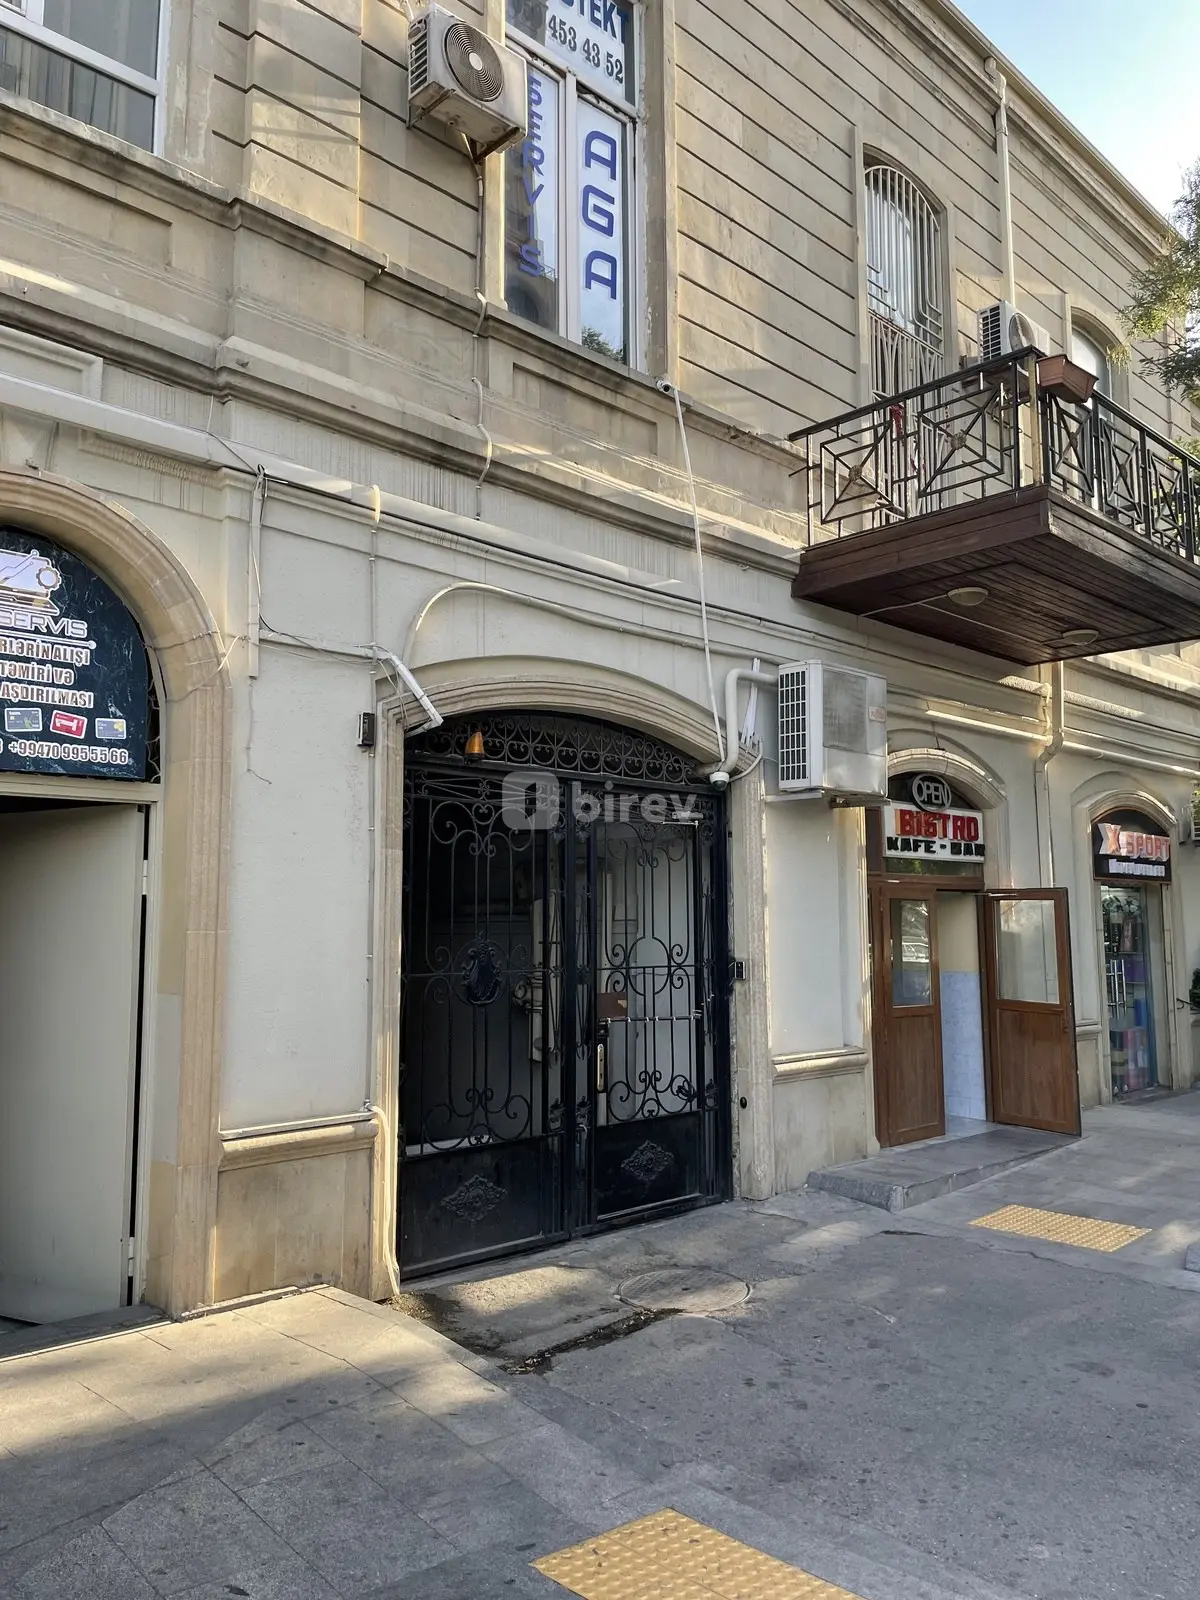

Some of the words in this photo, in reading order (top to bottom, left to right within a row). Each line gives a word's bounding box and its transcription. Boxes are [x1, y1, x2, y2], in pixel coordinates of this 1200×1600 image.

[549, 14, 577, 52] 453
[583, 38, 601, 68] 43
[606, 52, 624, 84] 52
[581, 130, 617, 300] AGA
[52, 645, 90, 666] ALIŞI
[53, 667, 74, 685] VƏ
[915, 781, 948, 805] OPEN
[887, 837, 936, 853] KAFE
